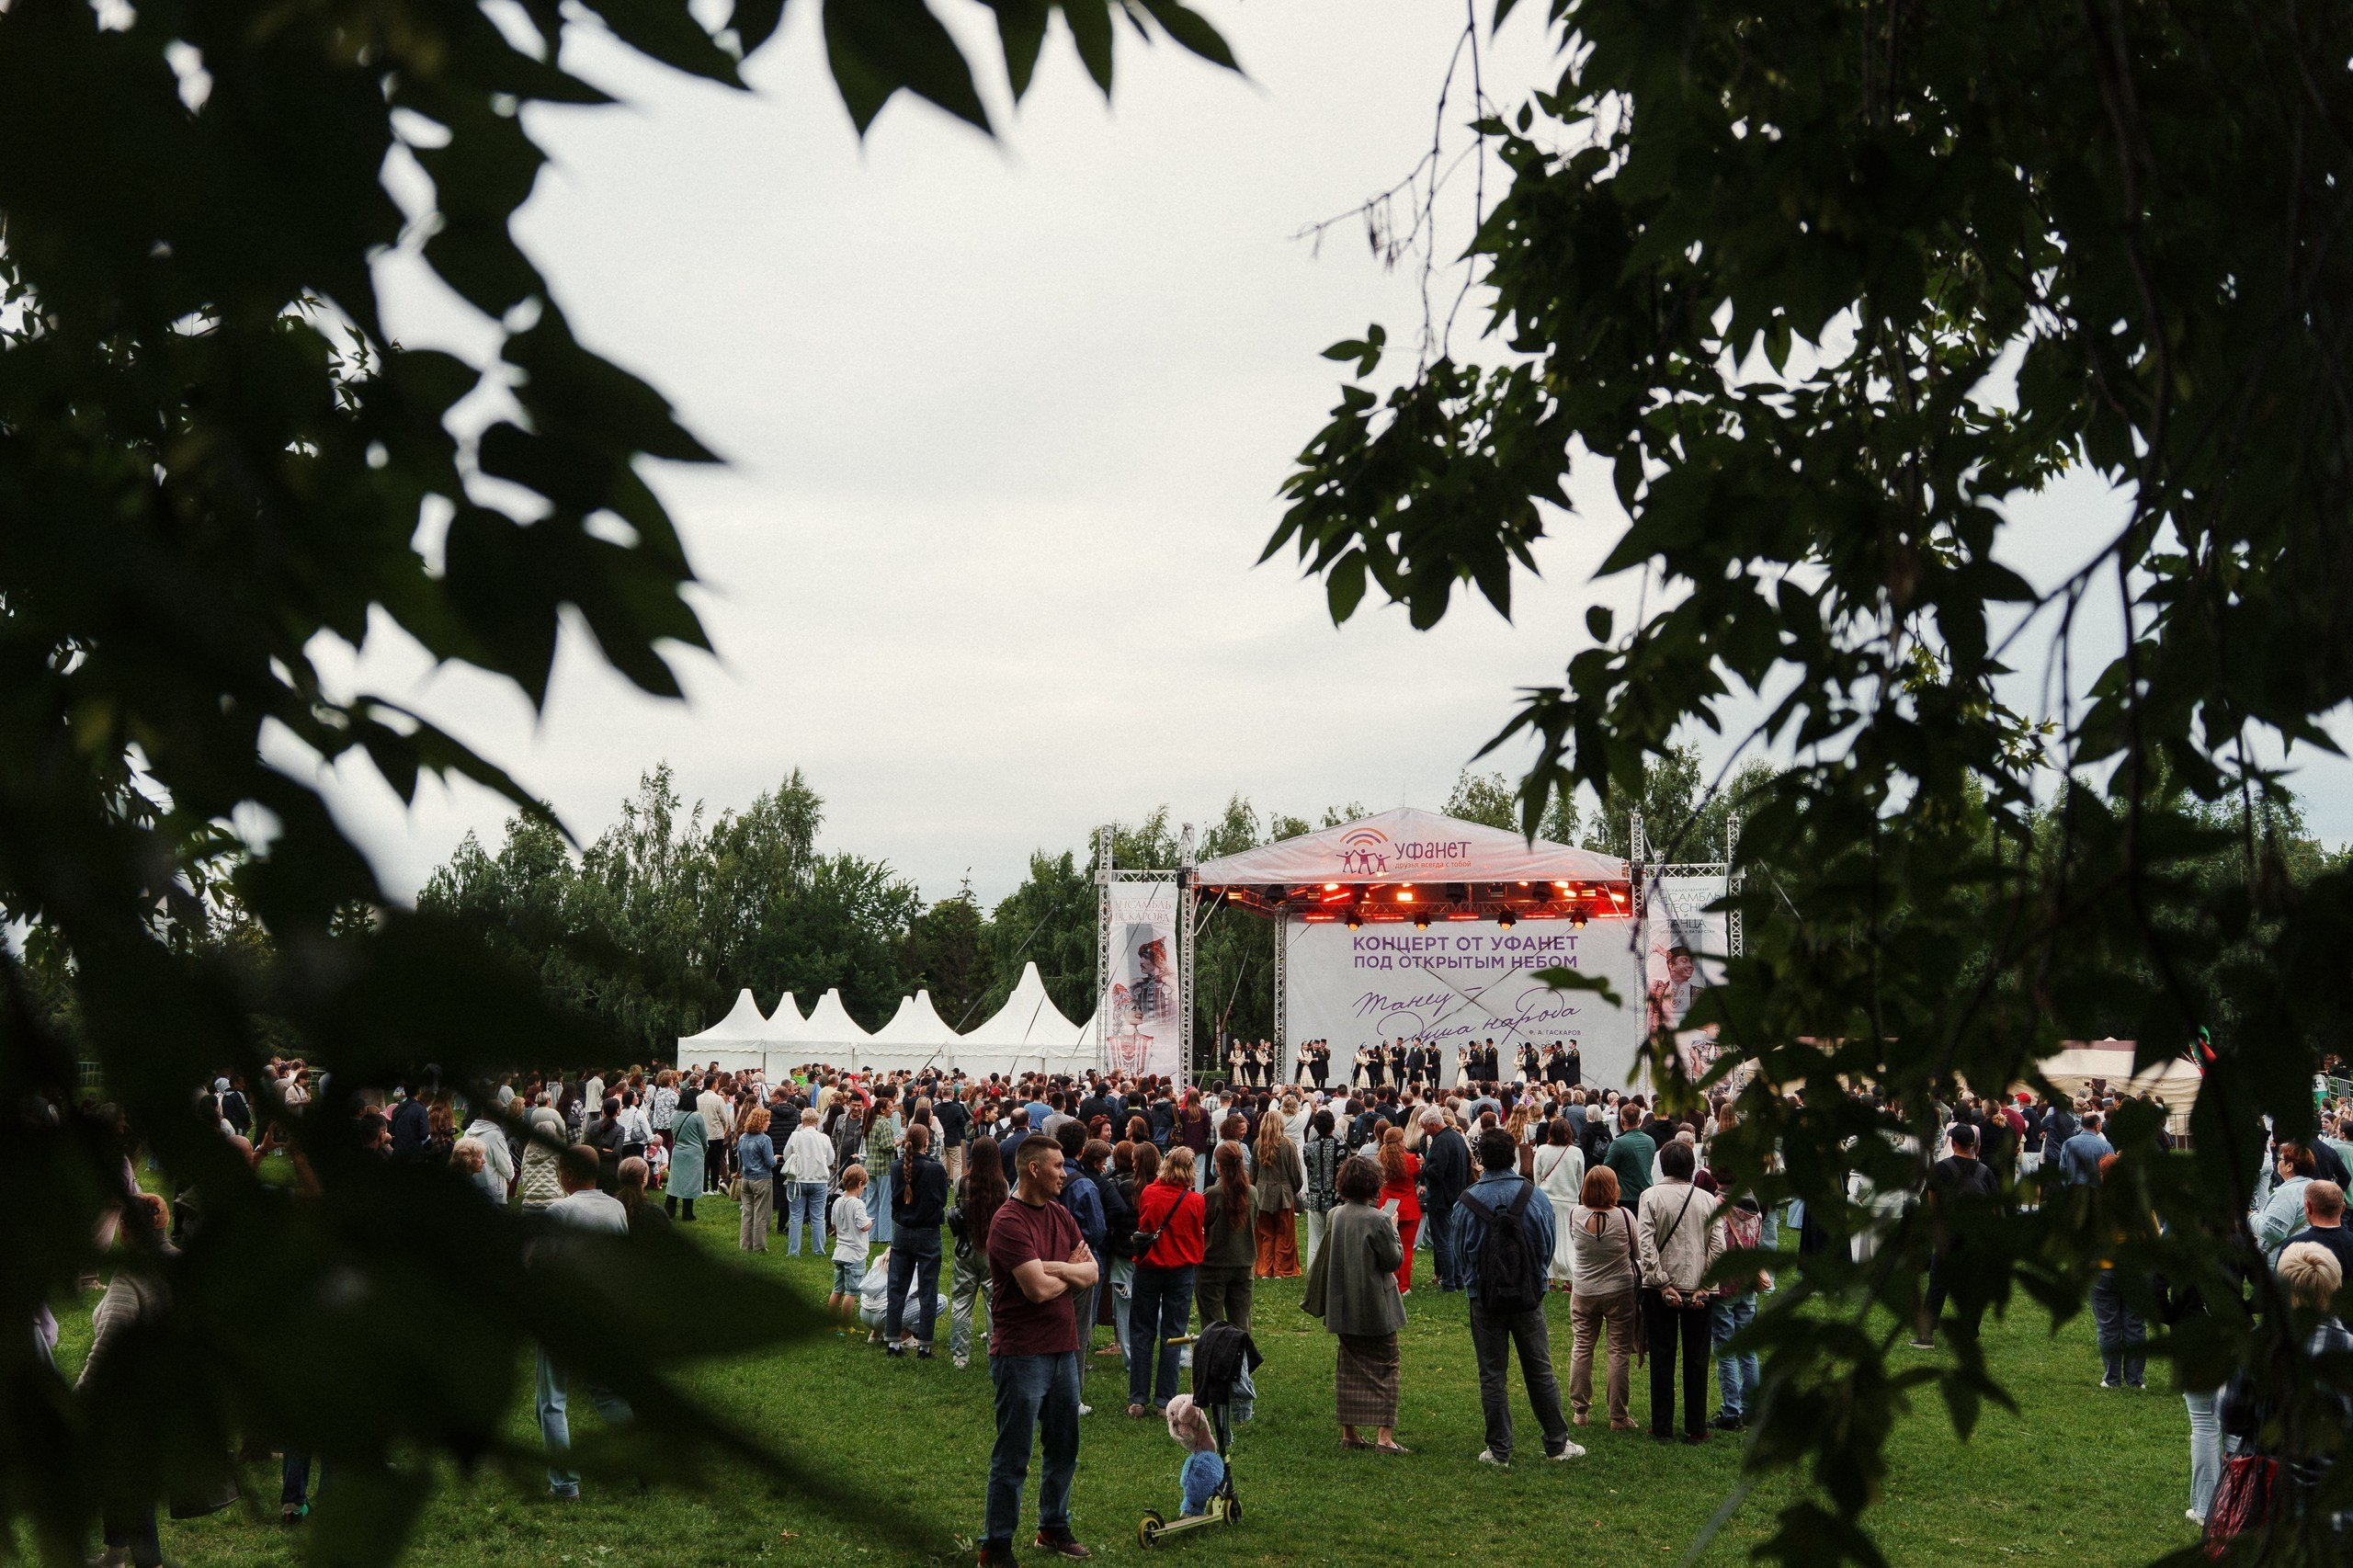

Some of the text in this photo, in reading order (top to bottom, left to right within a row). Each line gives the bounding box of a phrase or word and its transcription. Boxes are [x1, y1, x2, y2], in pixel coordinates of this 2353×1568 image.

[1666, 918, 1707, 929] ТАНЦА
[1353, 936, 1579, 953] КОНЦЕРТ ОТ УФАНЕТ
[1354, 955, 1578, 971] ПОД ОТКРЫТЫМ НЕБОМ
